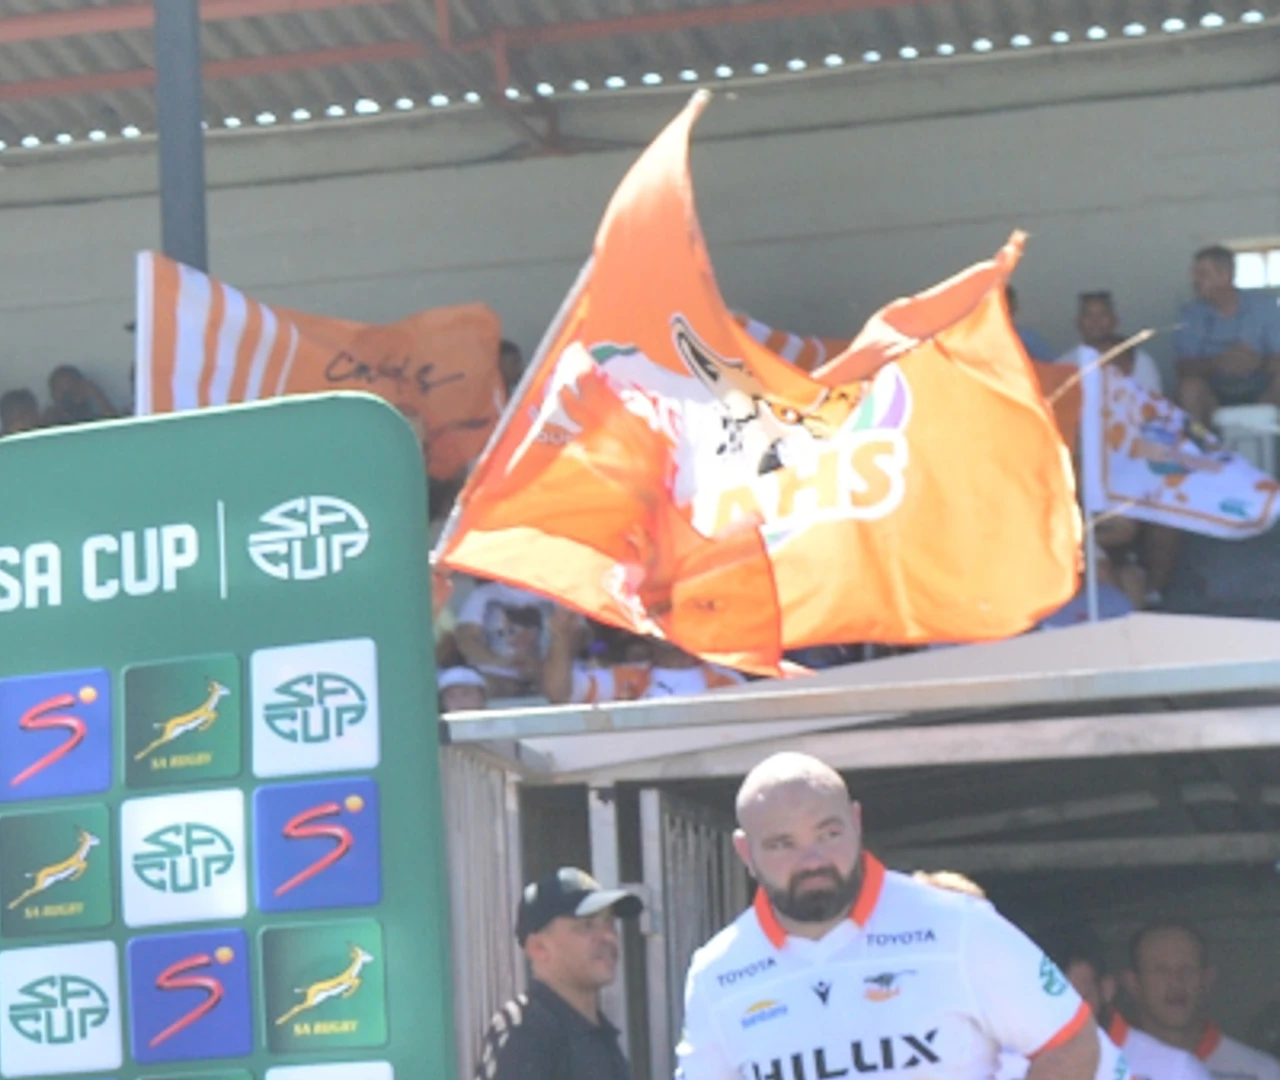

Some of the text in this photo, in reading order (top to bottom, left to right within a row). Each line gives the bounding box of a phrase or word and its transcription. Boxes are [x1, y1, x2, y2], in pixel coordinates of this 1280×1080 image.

[81, 523, 198, 602] CUP
[867, 929, 937, 946] TOYOTA
[718, 957, 778, 987] TOYOTA
